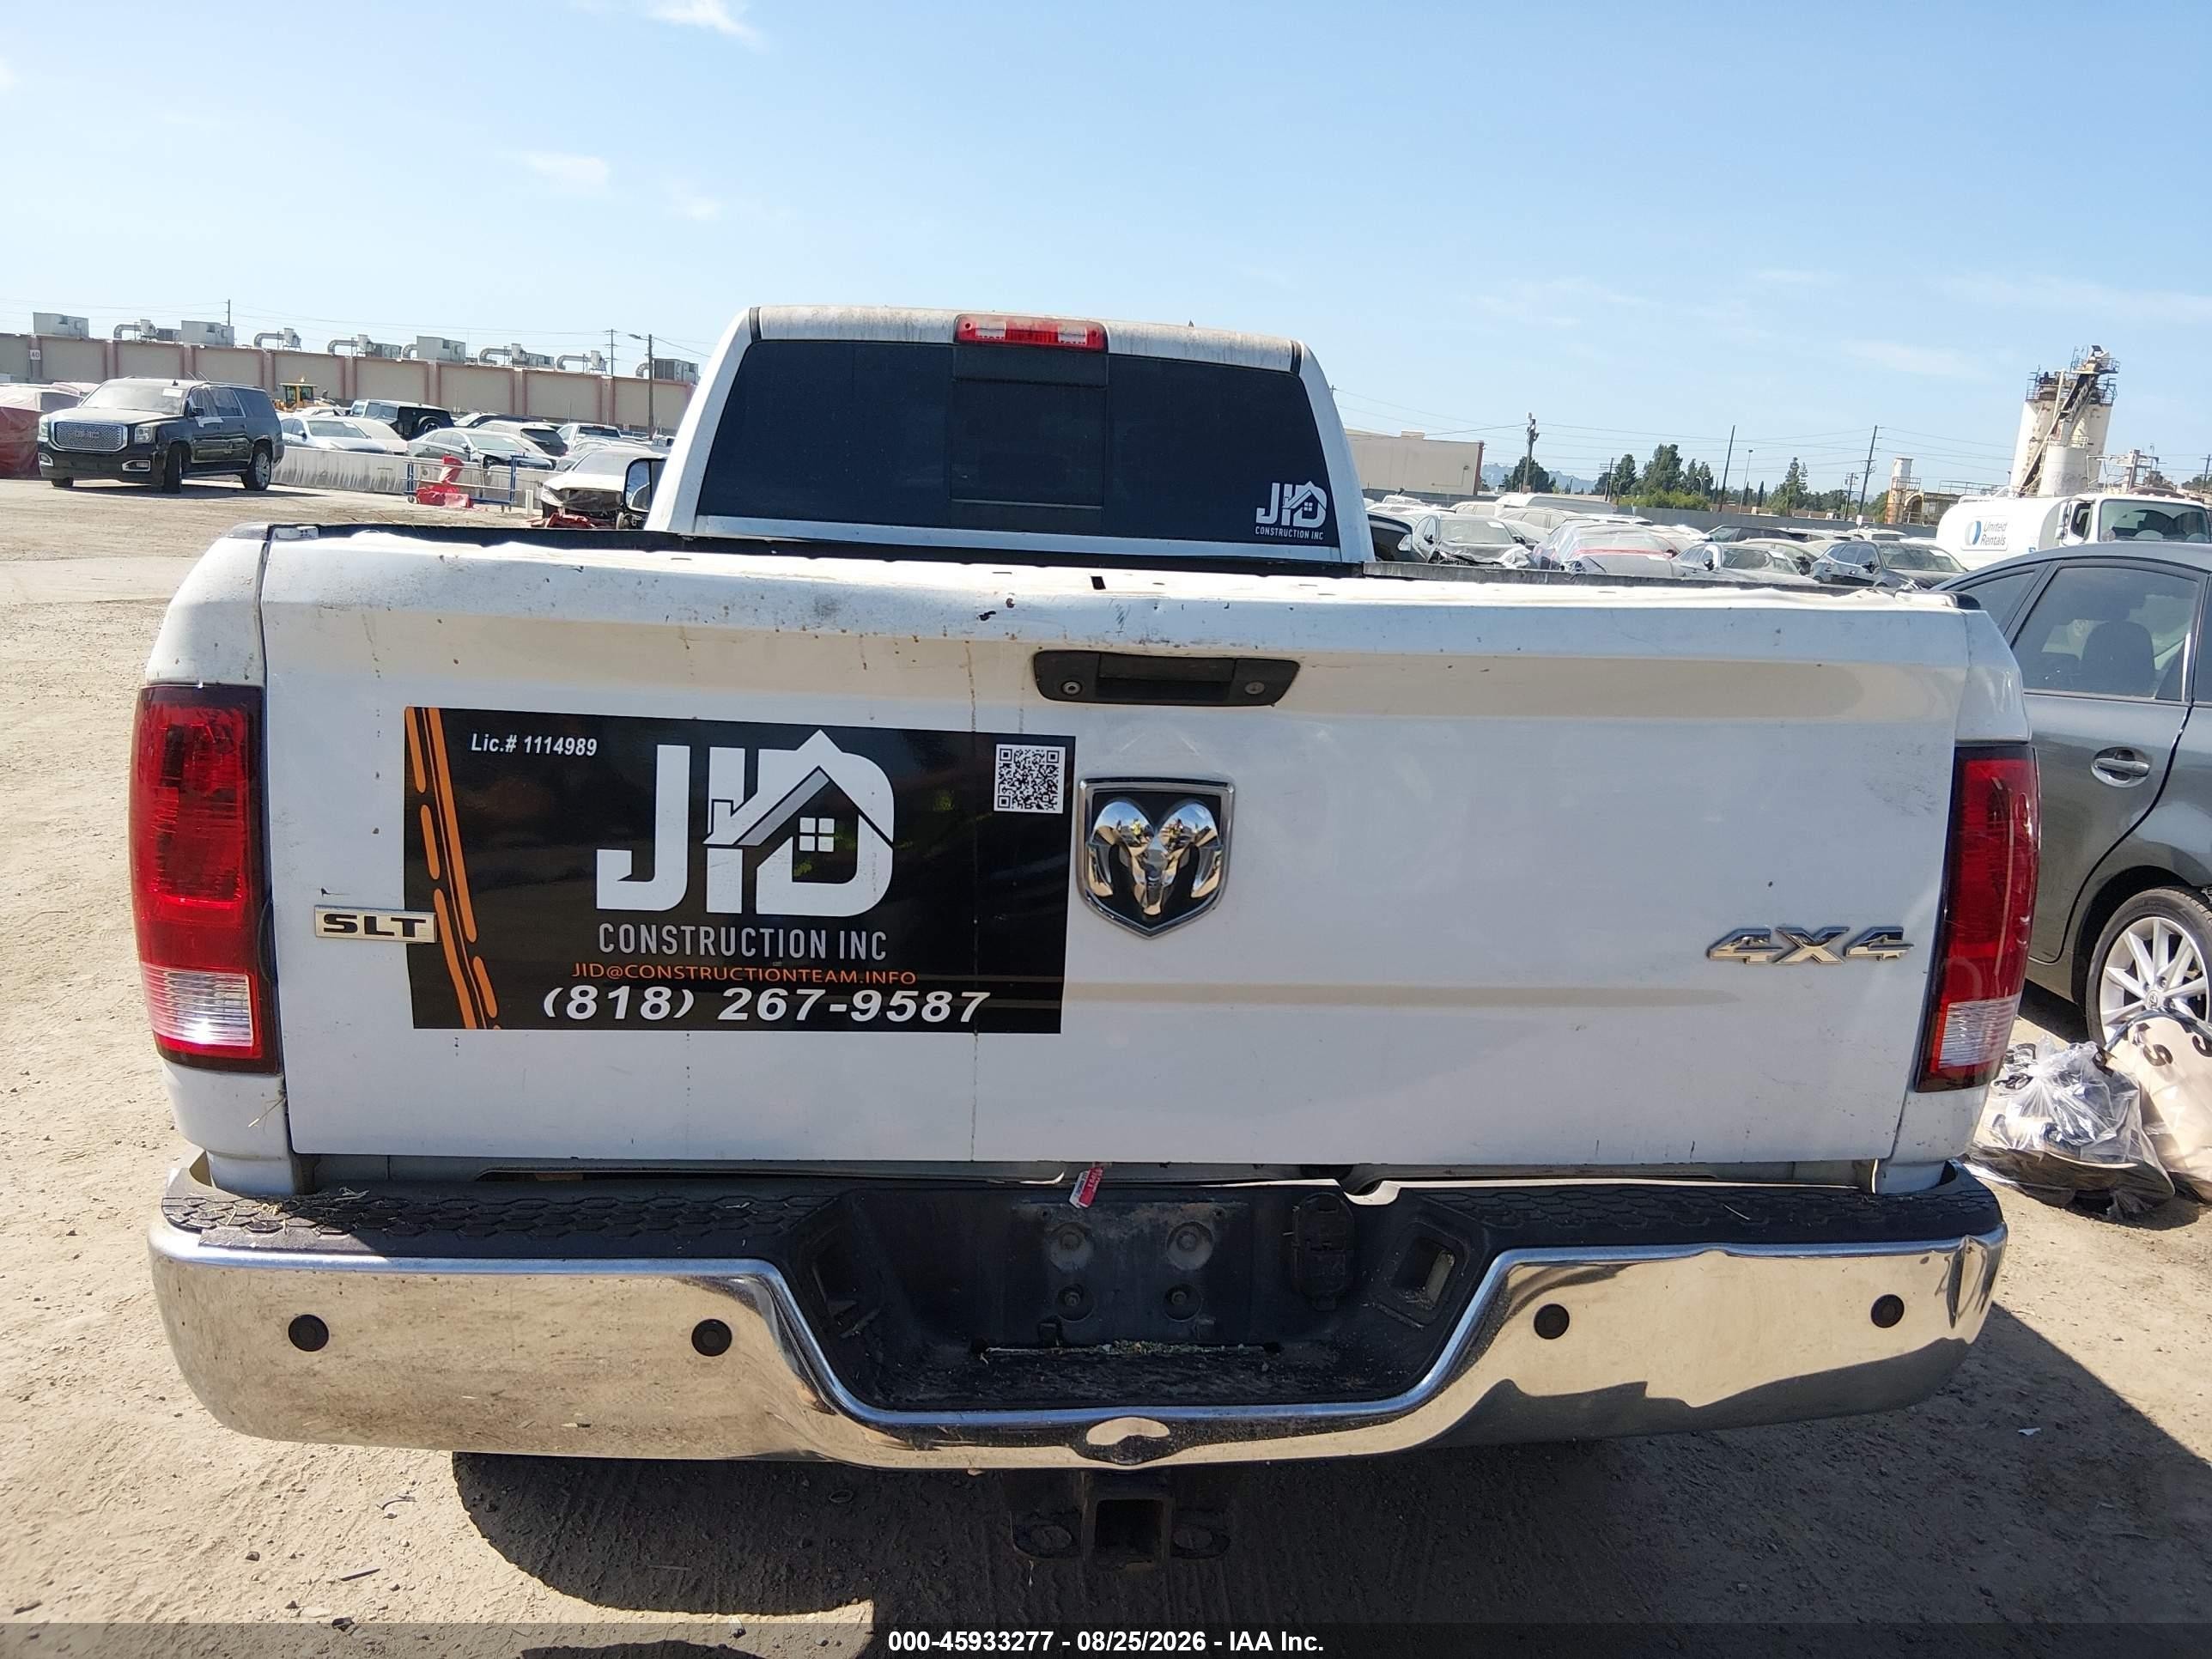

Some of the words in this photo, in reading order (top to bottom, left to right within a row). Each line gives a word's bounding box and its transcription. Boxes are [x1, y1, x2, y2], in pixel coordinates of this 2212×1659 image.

[1255, 526, 1310, 539] CONSTRUCTION
[1310, 531, 1324, 541] INC
[1983, 520, 2008, 532] United
[1980, 533, 2007, 546] Rentals
[471, 733, 518, 753] Lic.#
[523, 735, 599, 757] 1114989
[596, 728, 895, 918] JID
[323, 913, 427, 939] SLT
[599, 922, 833, 960] CONSTRUCTION
[838, 929, 888, 962] INC
[572, 962, 917, 987] JID@CONSTRUCTIONTEAM.INFO
[544, 985, 695, 1021] (818)
[717, 987, 991, 1024] 267-9587
